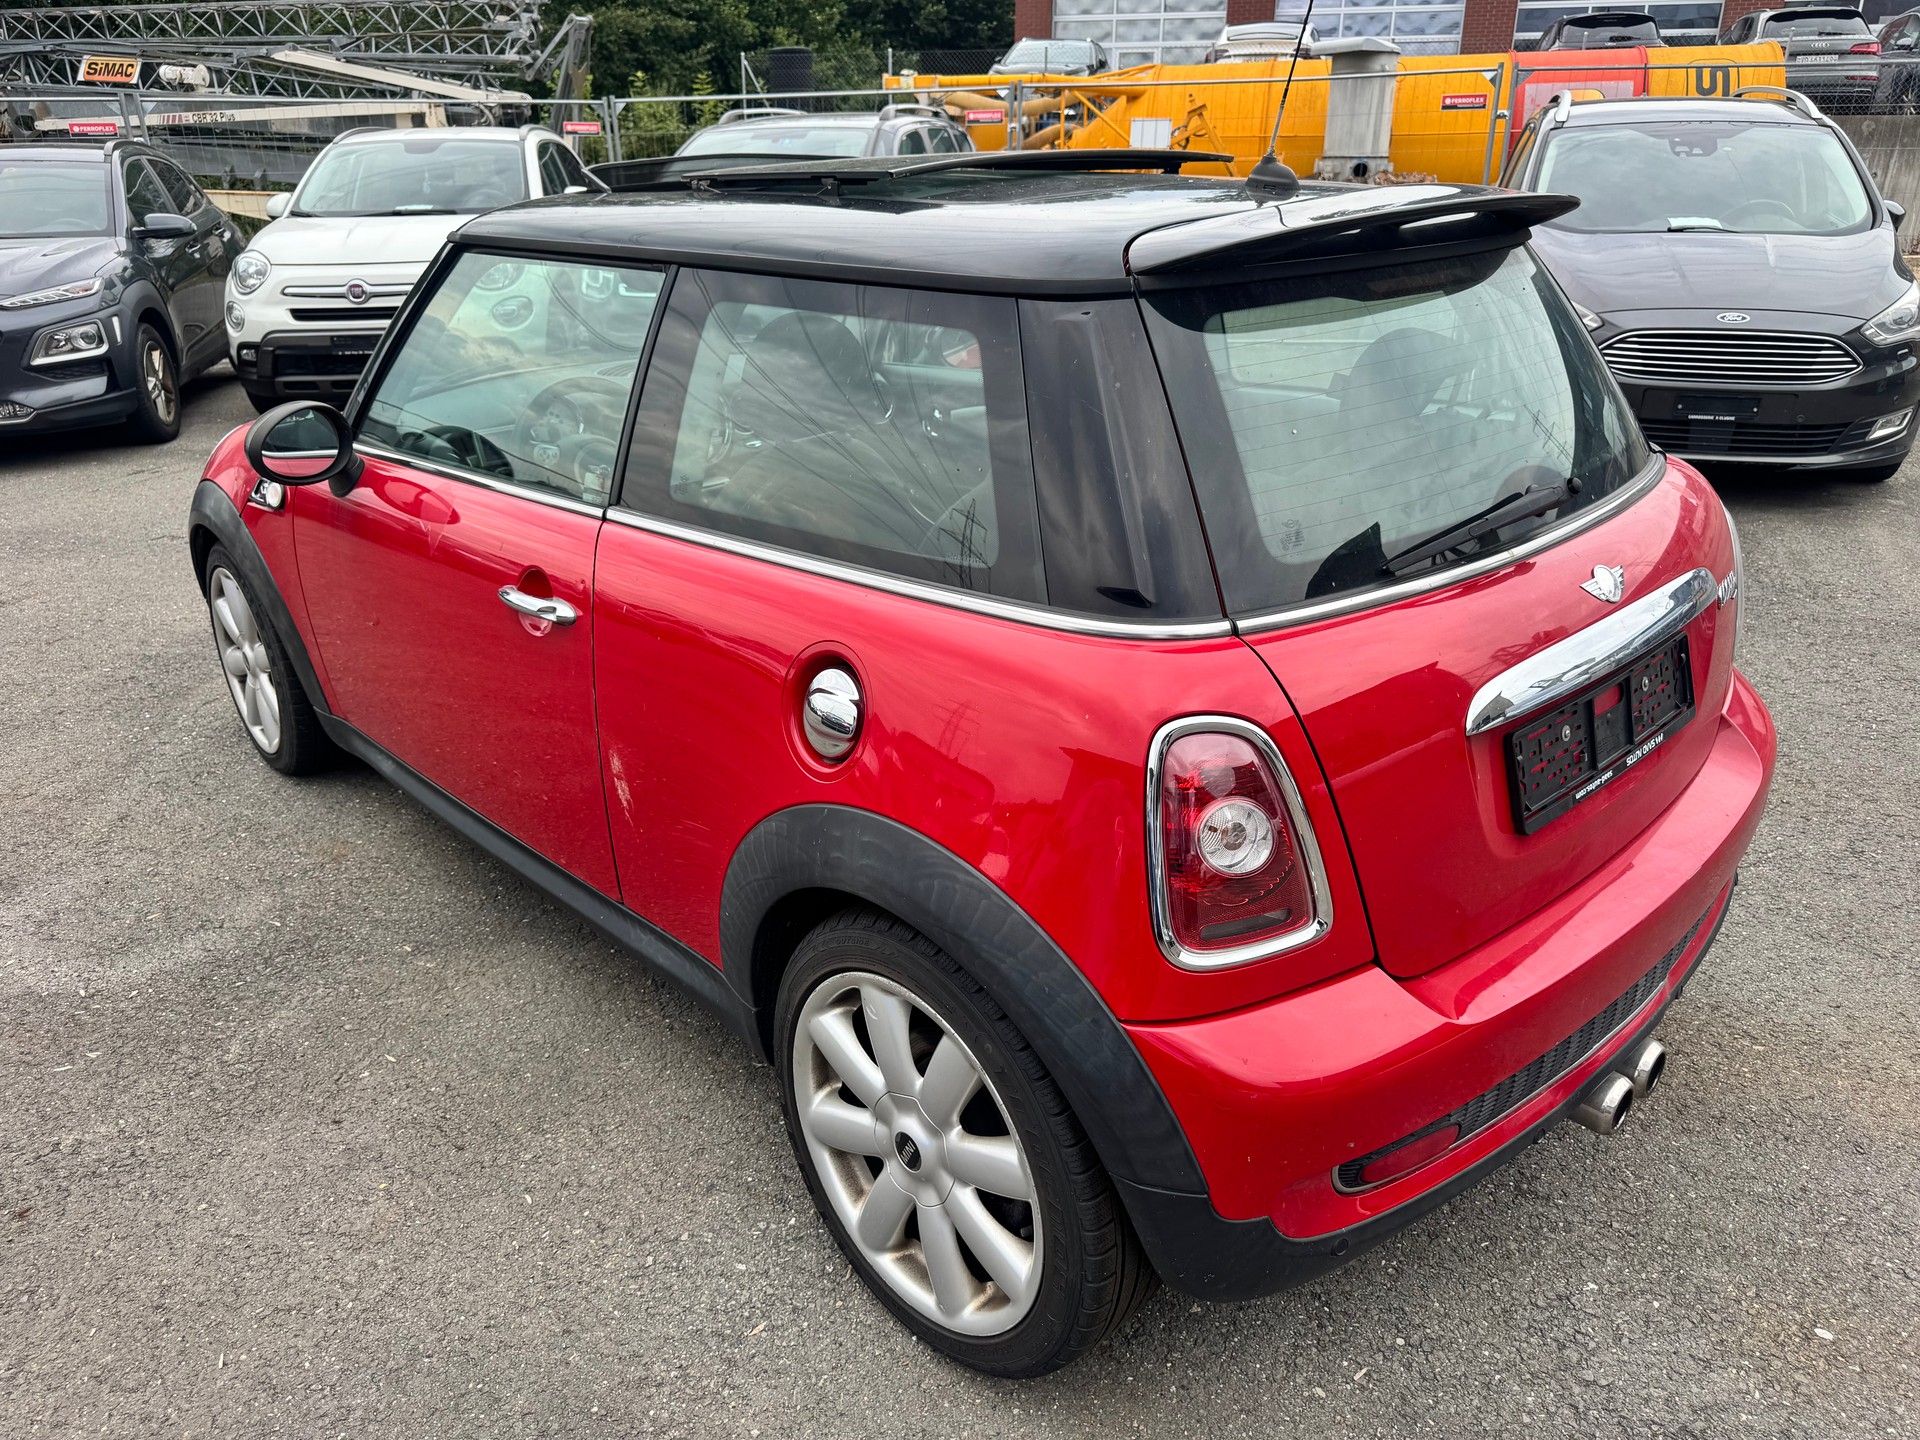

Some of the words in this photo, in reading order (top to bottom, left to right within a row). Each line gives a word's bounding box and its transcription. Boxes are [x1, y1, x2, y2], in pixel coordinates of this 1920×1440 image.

[86, 62, 135, 79] SiMAC
[208, 112, 219, 123] 32
[899, 1140, 917, 1165] MINI
